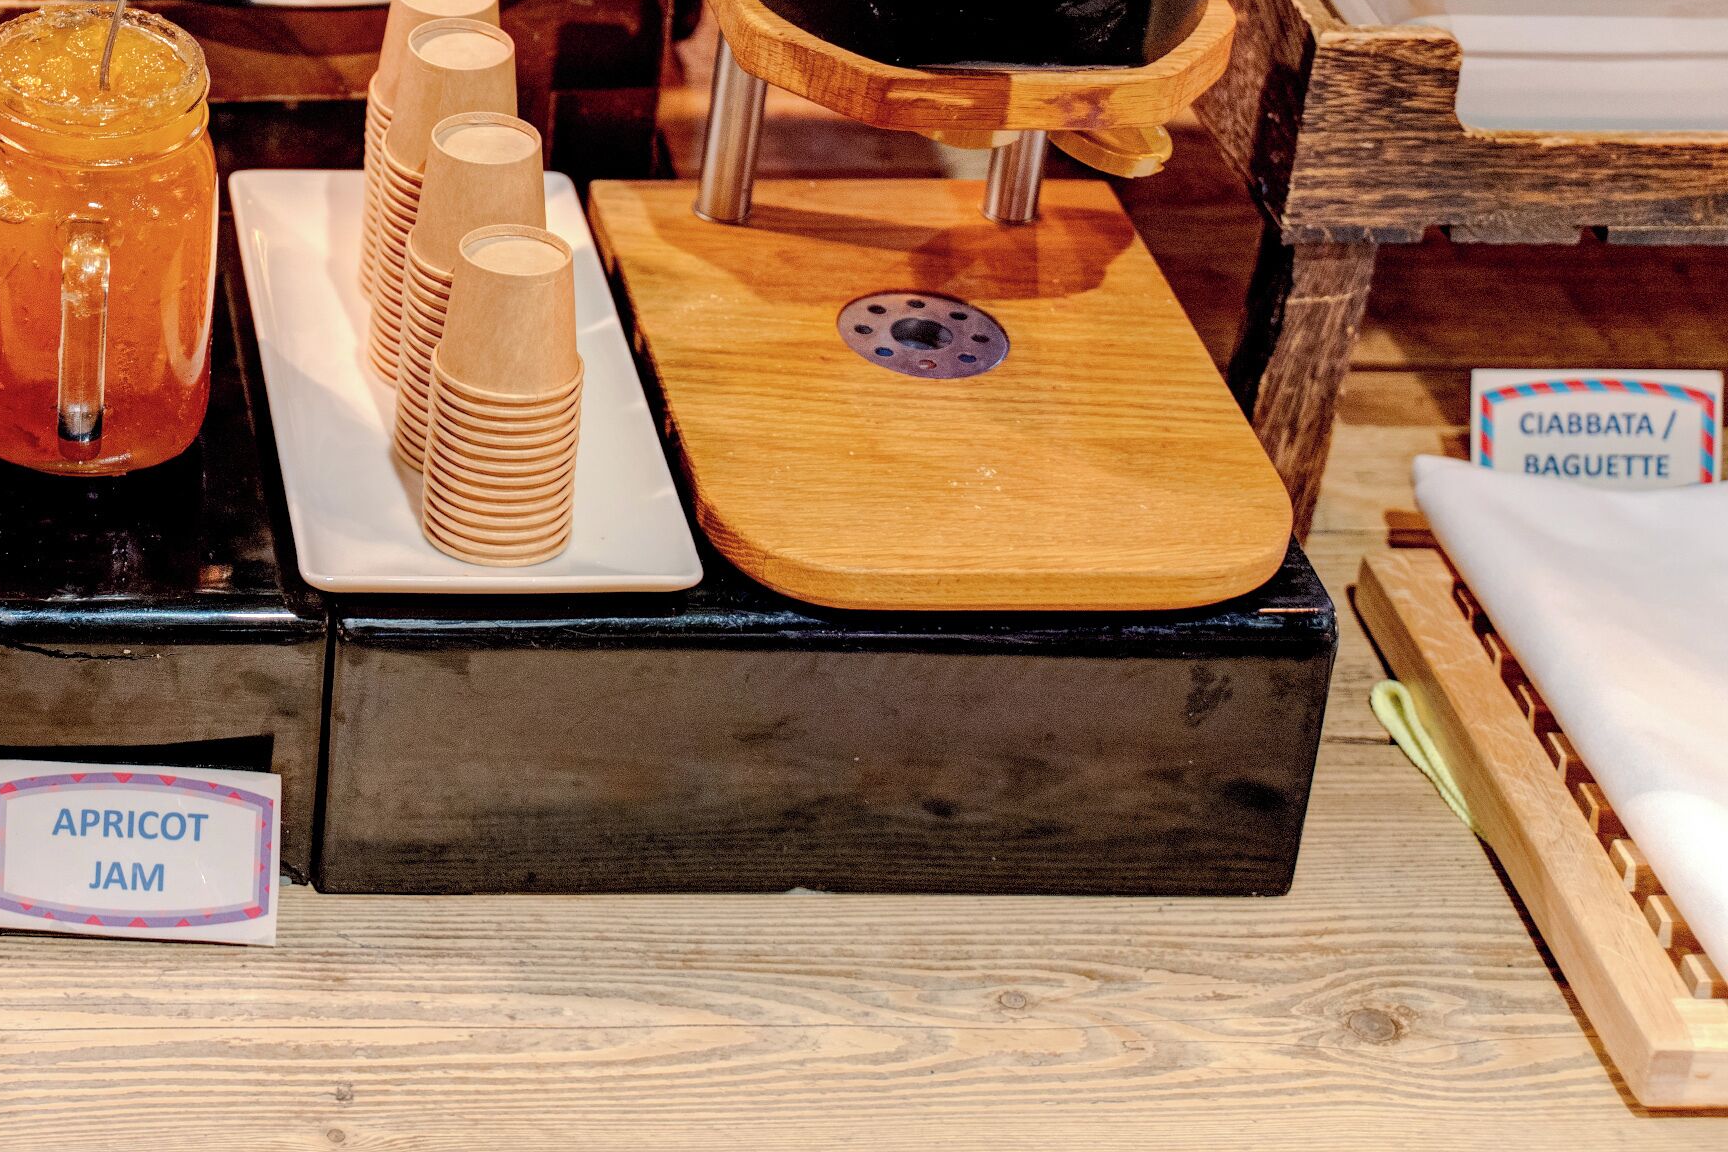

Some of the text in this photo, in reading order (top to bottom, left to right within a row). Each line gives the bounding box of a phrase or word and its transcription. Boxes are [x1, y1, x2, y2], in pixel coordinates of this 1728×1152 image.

[1519, 413, 1654, 436] CIABBATA
[1523, 454, 1669, 479] BAGUETTE
[51, 806, 210, 843] APRICOT
[88, 860, 165, 893] JAM
